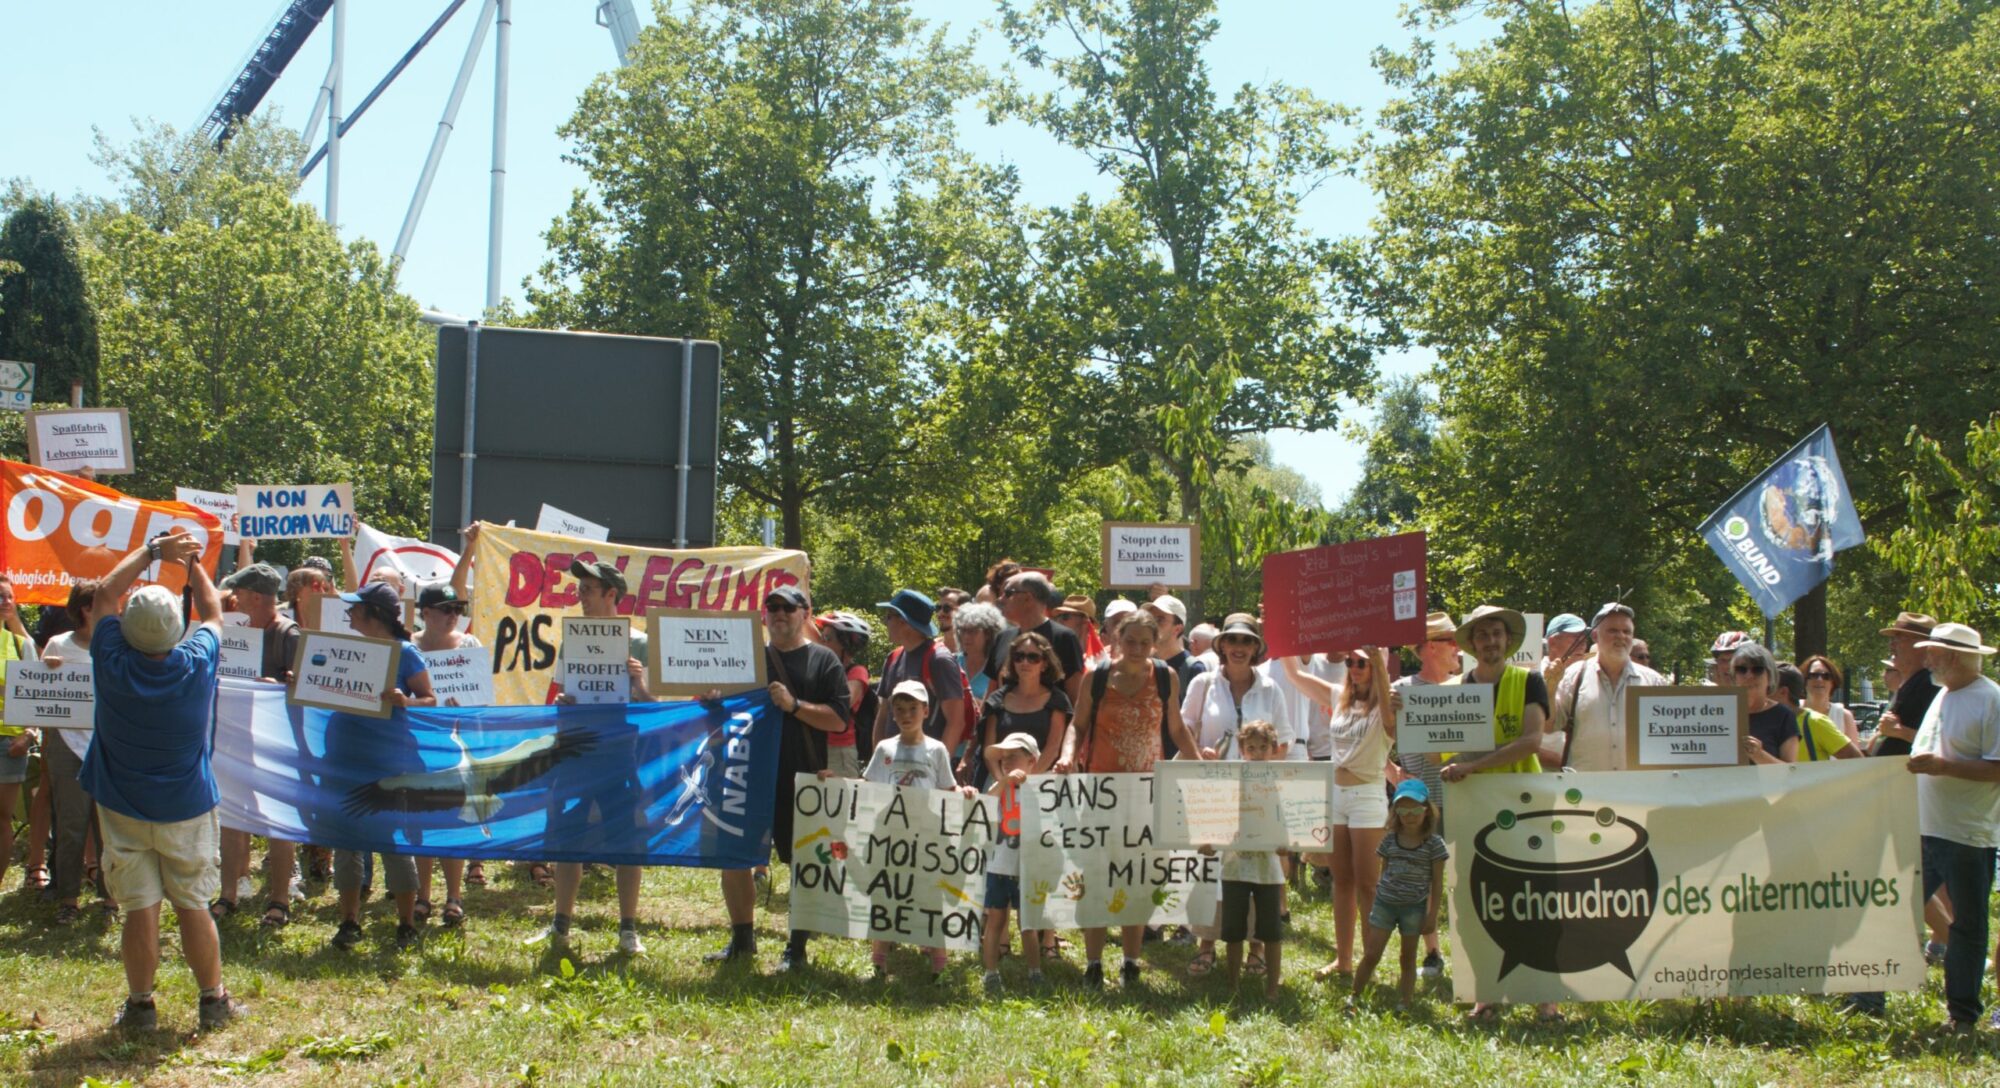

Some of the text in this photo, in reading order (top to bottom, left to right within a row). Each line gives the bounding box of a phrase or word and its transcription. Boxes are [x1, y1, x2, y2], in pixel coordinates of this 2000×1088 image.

[52, 423, 108, 435] Spaßfabrik
[46, 447, 119, 459] Lebensqualität
[257, 489, 341, 509] NON A
[240, 514, 310, 537] EUROPA
[562, 519, 585, 535] Spaß
[1121, 534, 1179, 547] Stoppt den
[1117, 549, 1184, 561] Expansions-
[1736, 538, 1781, 585] BUND
[1136, 564, 1166, 574] wahn
[568, 623, 623, 638] NATUR
[684, 628, 728, 642] NEIN!
[493, 614, 556, 675] PAS
[587, 644, 604, 655] vs.
[328, 647, 366, 664] NEIN!
[333, 666, 349, 674] zur
[567, 662, 626, 676] PROFIT-
[667, 656, 748, 671] Europa Valley
[19, 668, 90, 684] Stoppt den
[218, 665, 257, 678] qualität
[434, 671, 464, 681] meets
[305, 673, 374, 694] SEILBAHN
[431, 682, 479, 694] reativität
[578, 680, 616, 693] GIER
[14, 685, 94, 699] Expansions-
[1409, 692, 1481, 708] Stoppt den
[35, 703, 71, 716] wahn
[1652, 704, 1724, 719] Stoppt den
[1405, 711, 1486, 725] Expansions-
[1428, 728, 1464, 740] wahn
[1648, 722, 1730, 736] Expansions-
[1670, 739, 1707, 752] wahn
[722, 712, 754, 816] NABU
[1039, 776, 1117, 812] SANS
[940, 798, 992, 841] LA
[1123, 825, 1153, 848] LA
[867, 869, 914, 900] AU
[1480, 870, 1899, 921] le chaudron des alternatives
[1654, 960, 1901, 985] chaudrondesalternatives.fr
